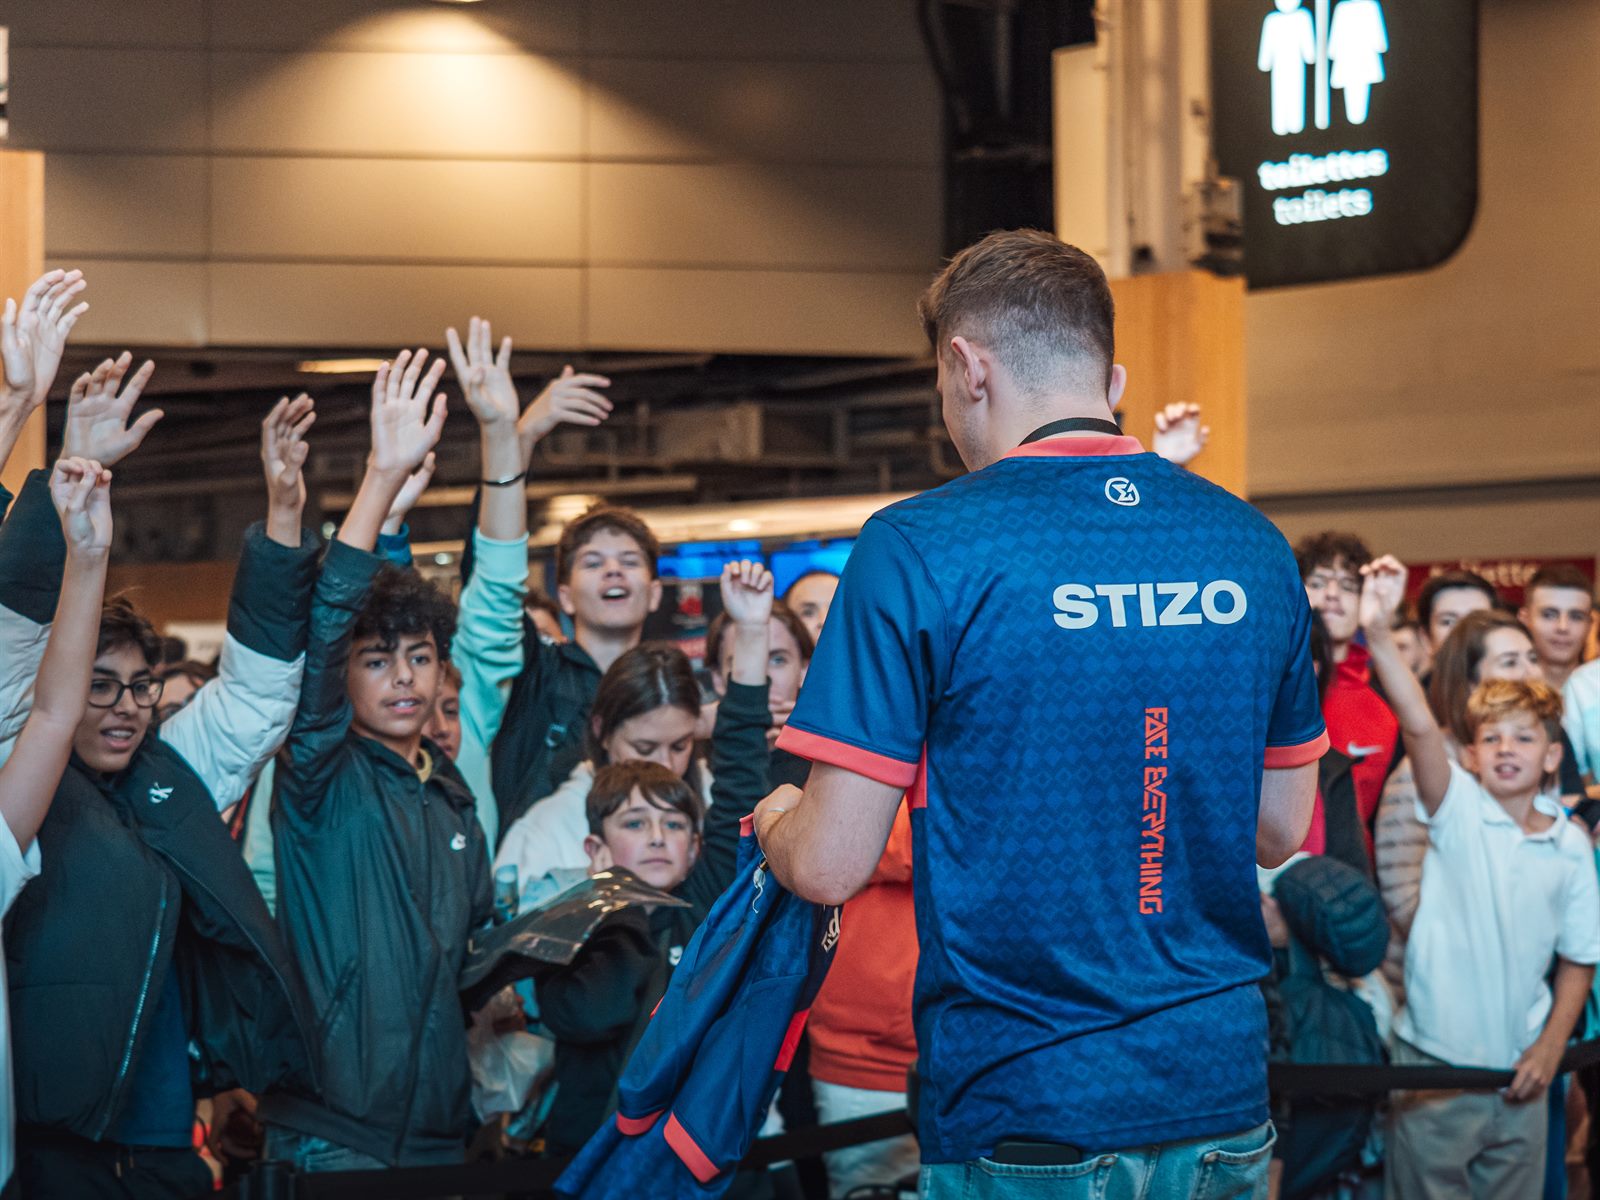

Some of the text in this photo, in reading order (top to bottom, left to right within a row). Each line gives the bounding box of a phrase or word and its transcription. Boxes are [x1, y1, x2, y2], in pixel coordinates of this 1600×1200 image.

[1258, 149, 1389, 190] toilettes
[1273, 188, 1373, 225] toilets
[1053, 580, 1247, 629] STIZO
[1139, 707, 1168, 914] FACE EVERYTHING
